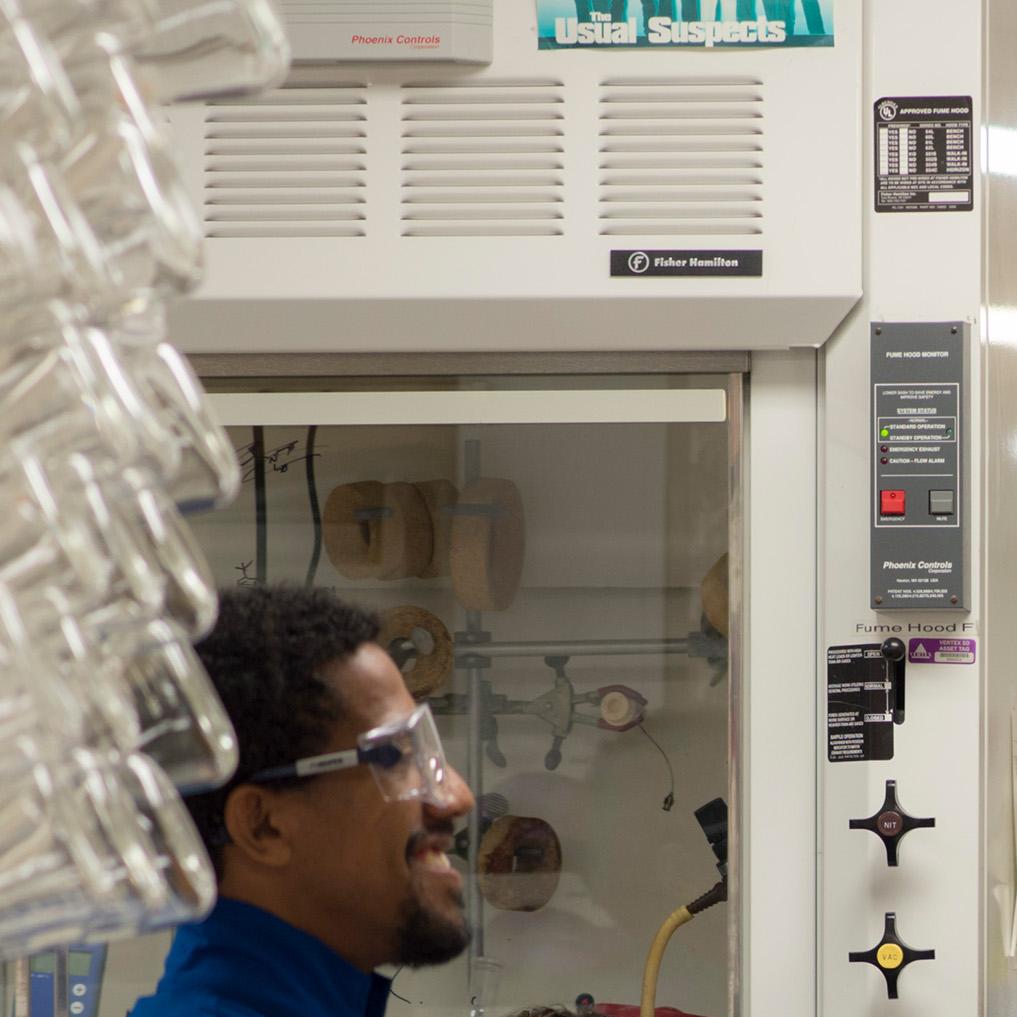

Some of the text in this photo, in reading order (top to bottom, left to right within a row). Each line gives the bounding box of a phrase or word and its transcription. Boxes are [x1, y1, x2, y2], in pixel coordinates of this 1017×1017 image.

[590, 11, 611, 22] The
[555, 16, 786, 47] Usual Suspects
[351, 34, 440, 44] Phoenix Controls
[654, 257, 738, 267] Fisher Hamilton
[883, 561, 952, 569] Phoenix Controls
[856, 623, 974, 633] Fume Hood F
